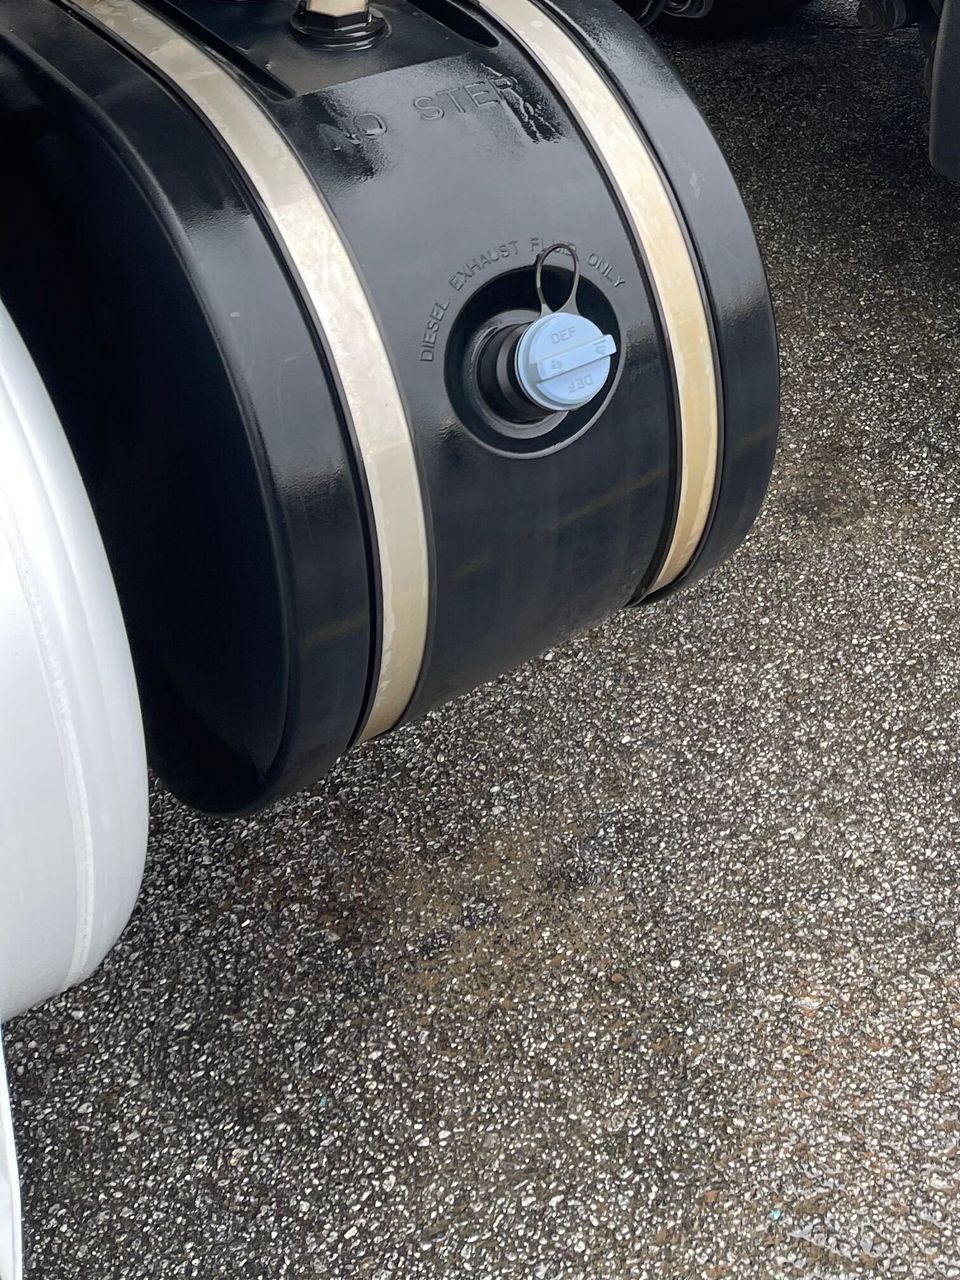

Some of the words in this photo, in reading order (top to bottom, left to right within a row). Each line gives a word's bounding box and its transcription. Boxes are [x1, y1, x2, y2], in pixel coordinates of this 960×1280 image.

[420, 300, 451, 362] DIESEL
[448, 239, 520, 292] EXHAUST
[587, 252, 626, 289] ONLY
[551, 326, 576, 344] DEF
